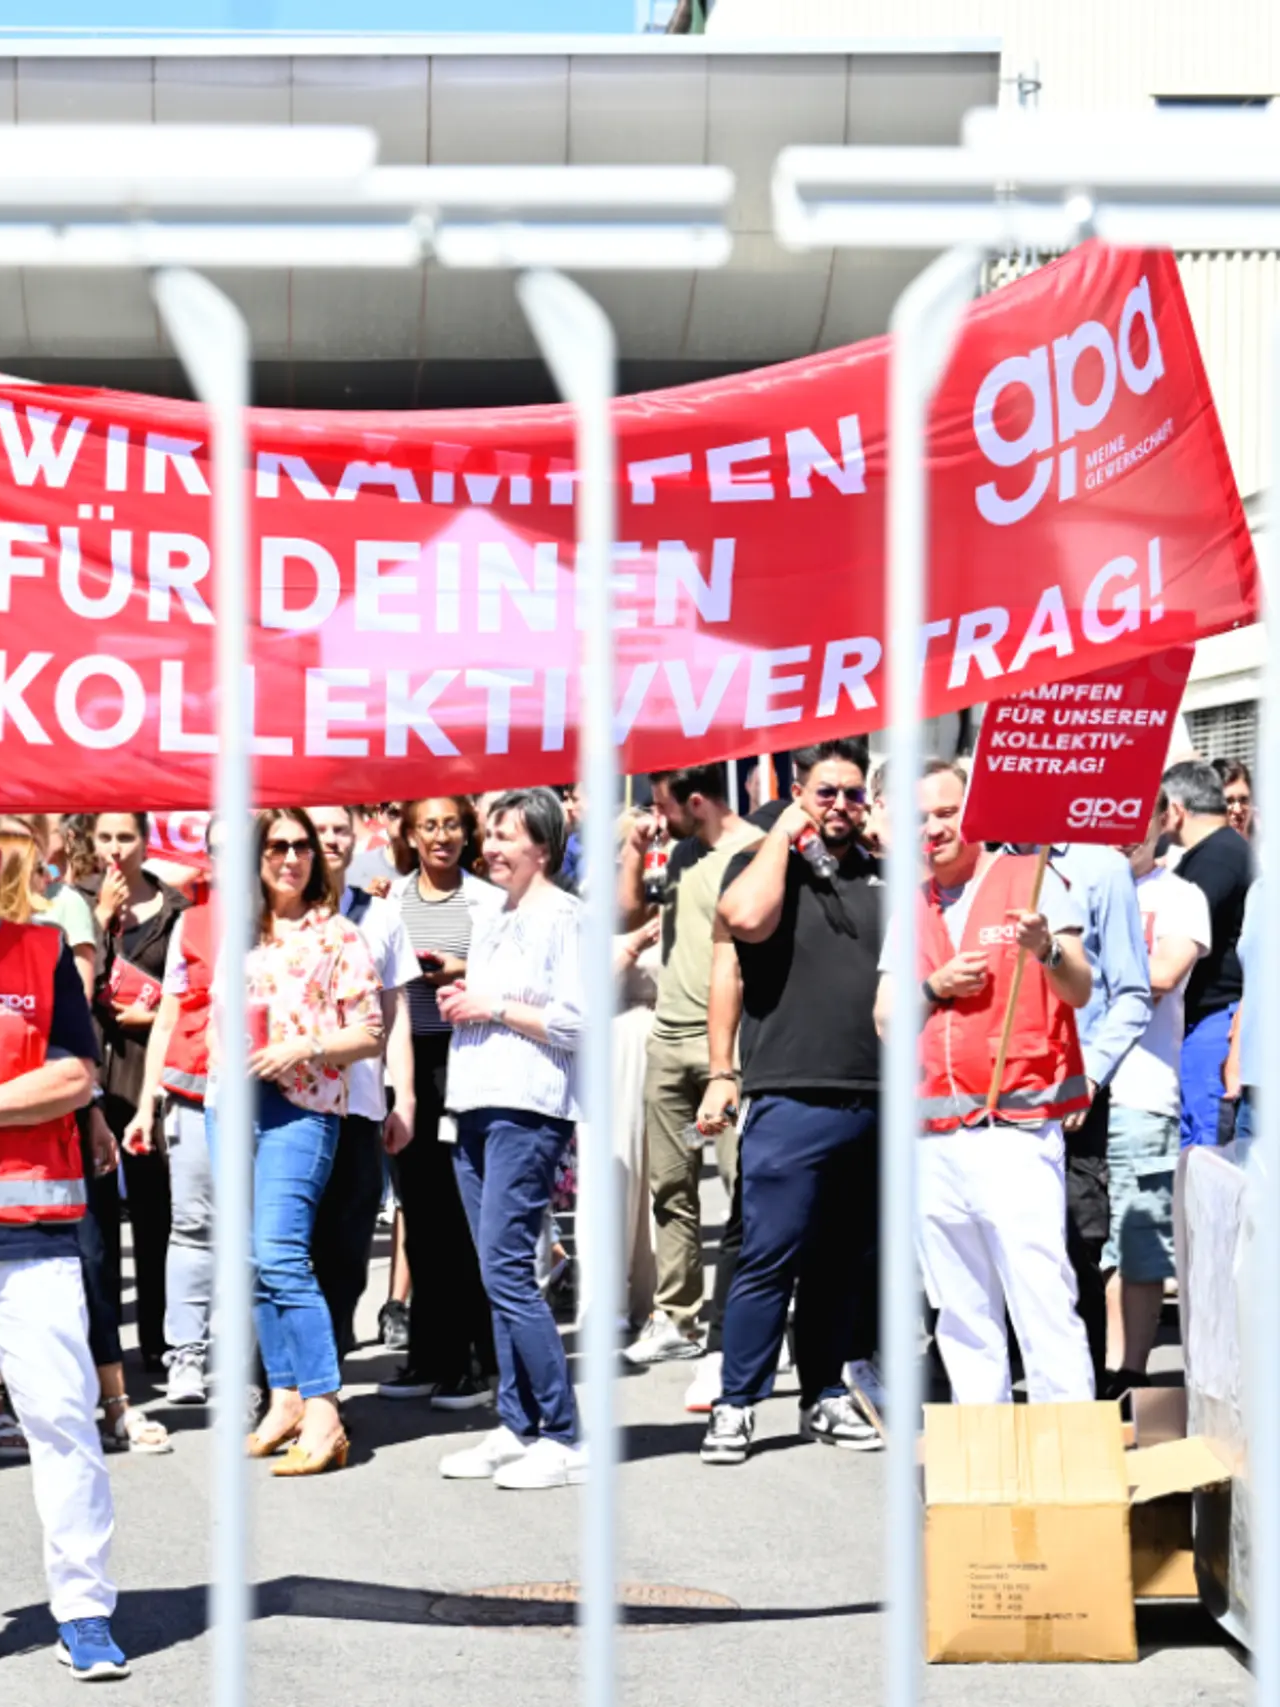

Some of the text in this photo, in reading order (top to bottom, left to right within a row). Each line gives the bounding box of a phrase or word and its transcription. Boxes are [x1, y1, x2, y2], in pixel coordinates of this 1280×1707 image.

[973, 274, 1166, 527] gpa
[256, 412, 867, 505] KMFEN
[1085, 433, 1126, 470] MEINE
[260, 536, 737, 635] DEINEN
[1003, 682, 1123, 701] MPFEN
[996, 704, 1168, 726] FÜR UNSEREN
[990, 730, 1135, 751] KOLLEKTIV-
[986, 755, 1106, 775] VERTRAG!
[1066, 797, 1143, 829] gpa
